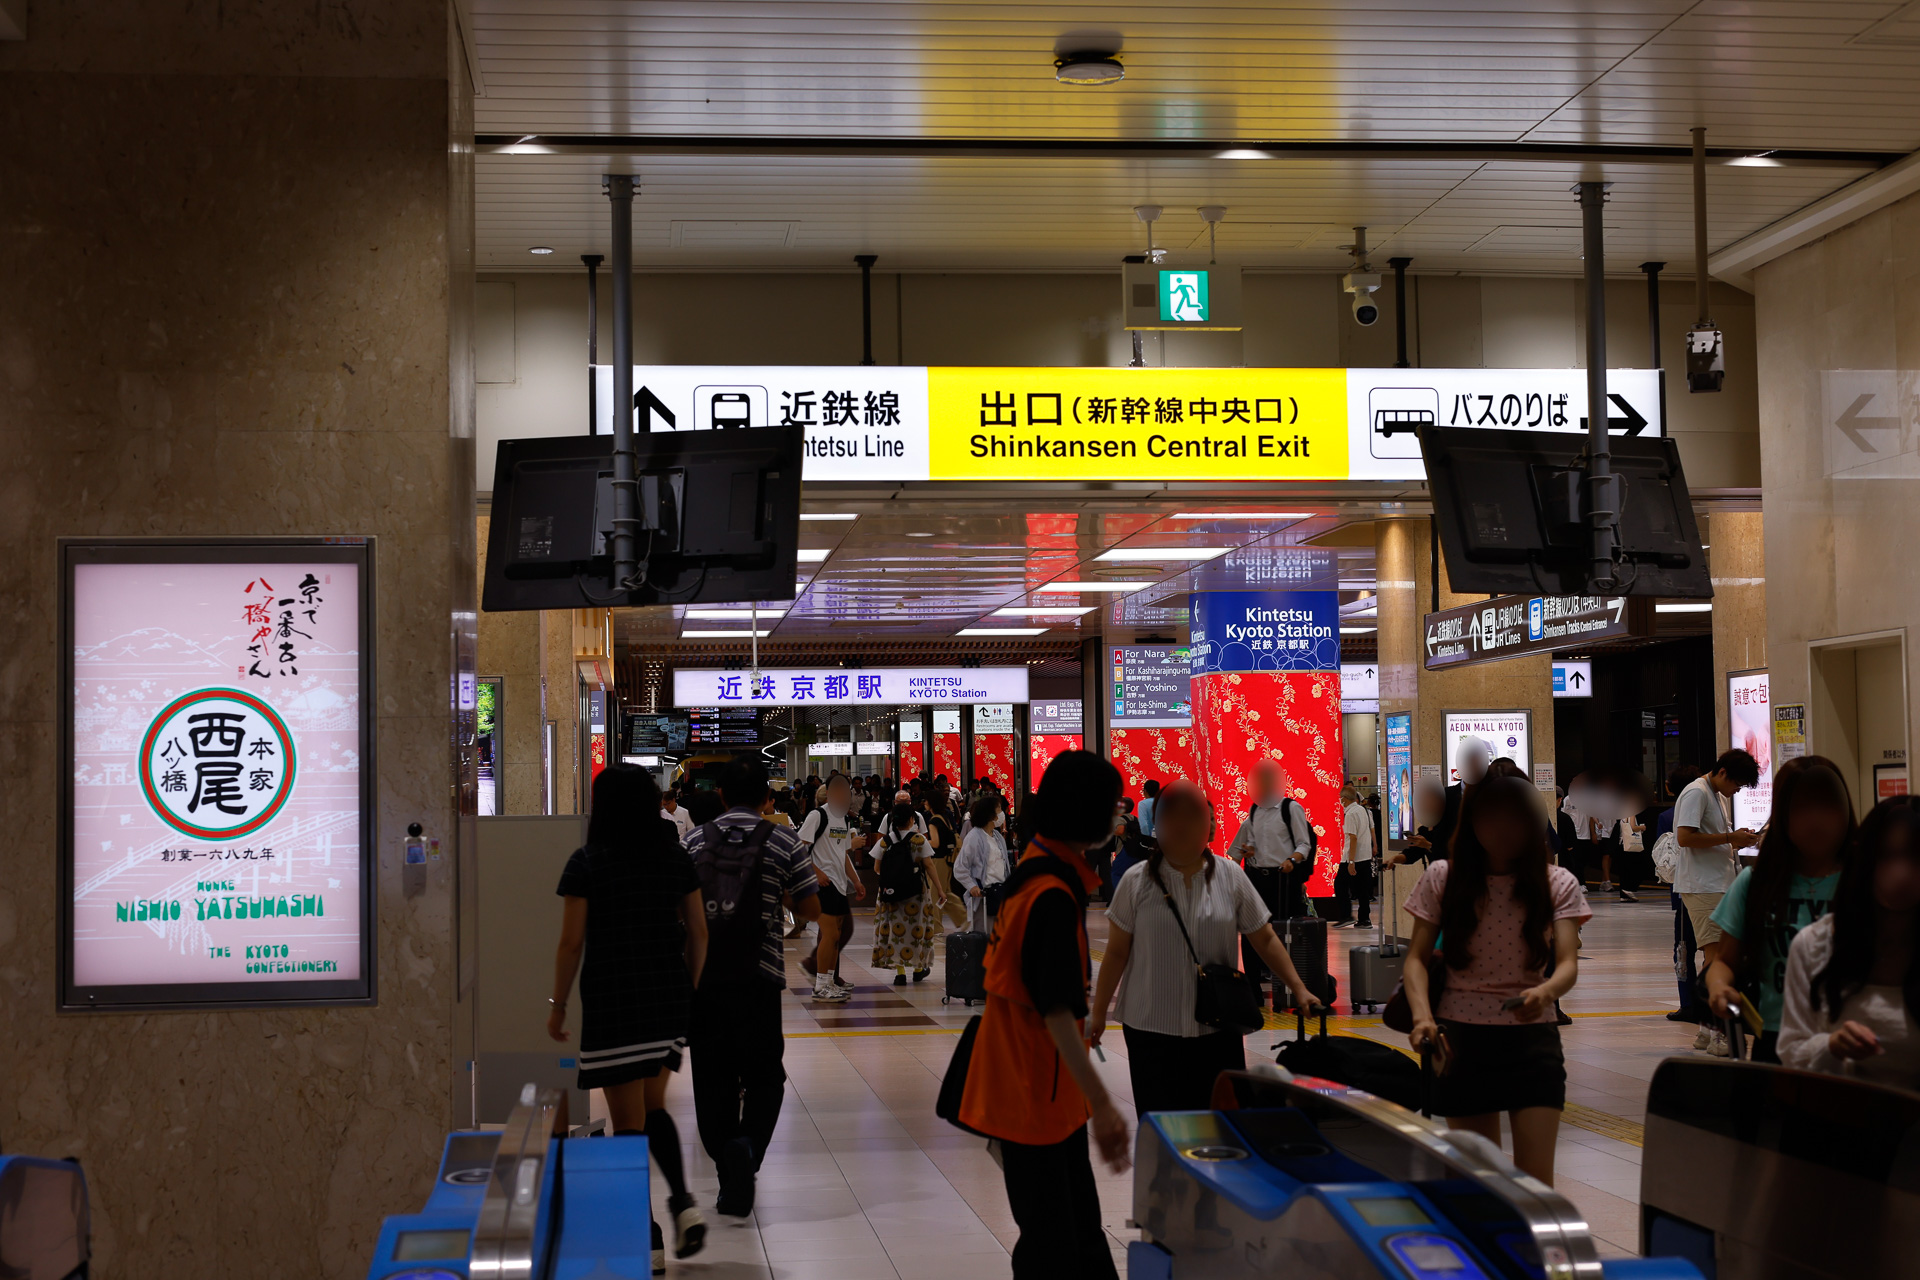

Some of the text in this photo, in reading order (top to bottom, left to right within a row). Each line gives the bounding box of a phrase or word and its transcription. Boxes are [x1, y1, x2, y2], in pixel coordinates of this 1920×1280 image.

[780, 390, 901, 427] 近鉄線
[1450, 393, 1569, 427] バスのりば
[804, 434, 904, 457] ntetsu Line
[970, 434, 1310, 458] Shinkansen Central Exit
[1246, 607, 1313, 622] Kintetsu
[1226, 623, 1332, 642] Kyoto Station
[1566, 620, 1580, 635] Tracks
[1251, 639, 1310, 650] 近鉄 京都駅
[1496, 631, 1521, 648] JR Lines
[1125, 649, 1139, 658] For
[1144, 649, 1166, 658] Nara
[1454, 642, 1465, 655] Line
[1125, 666, 1135, 675] For
[1138, 666, 1191, 676] Kashiharajingu-ma
[790, 675, 883, 700] 京都駅
[909, 678, 962, 687] KINTETSU
[1125, 684, 1139, 692] For
[1144, 683, 1178, 692] Yoshino
[951, 688, 987, 698] Station
[1734, 683, 1769, 706] 誠意で包
[1126, 701, 1136, 709] For
[1138, 700, 1167, 709] Ise-Shima
[1449, 722, 1524, 732] AEON MALL KYOTO
[187, 712, 248, 815] 西尾
[248, 737, 275, 791] 本家
[161, 848, 275, 862] 創業一六八九年
[116, 894, 324, 923] NISHIO YATSUHASHI
[209, 944, 289, 959] THE KYOTO
[246, 960, 338, 974] CONFECTIONERY
